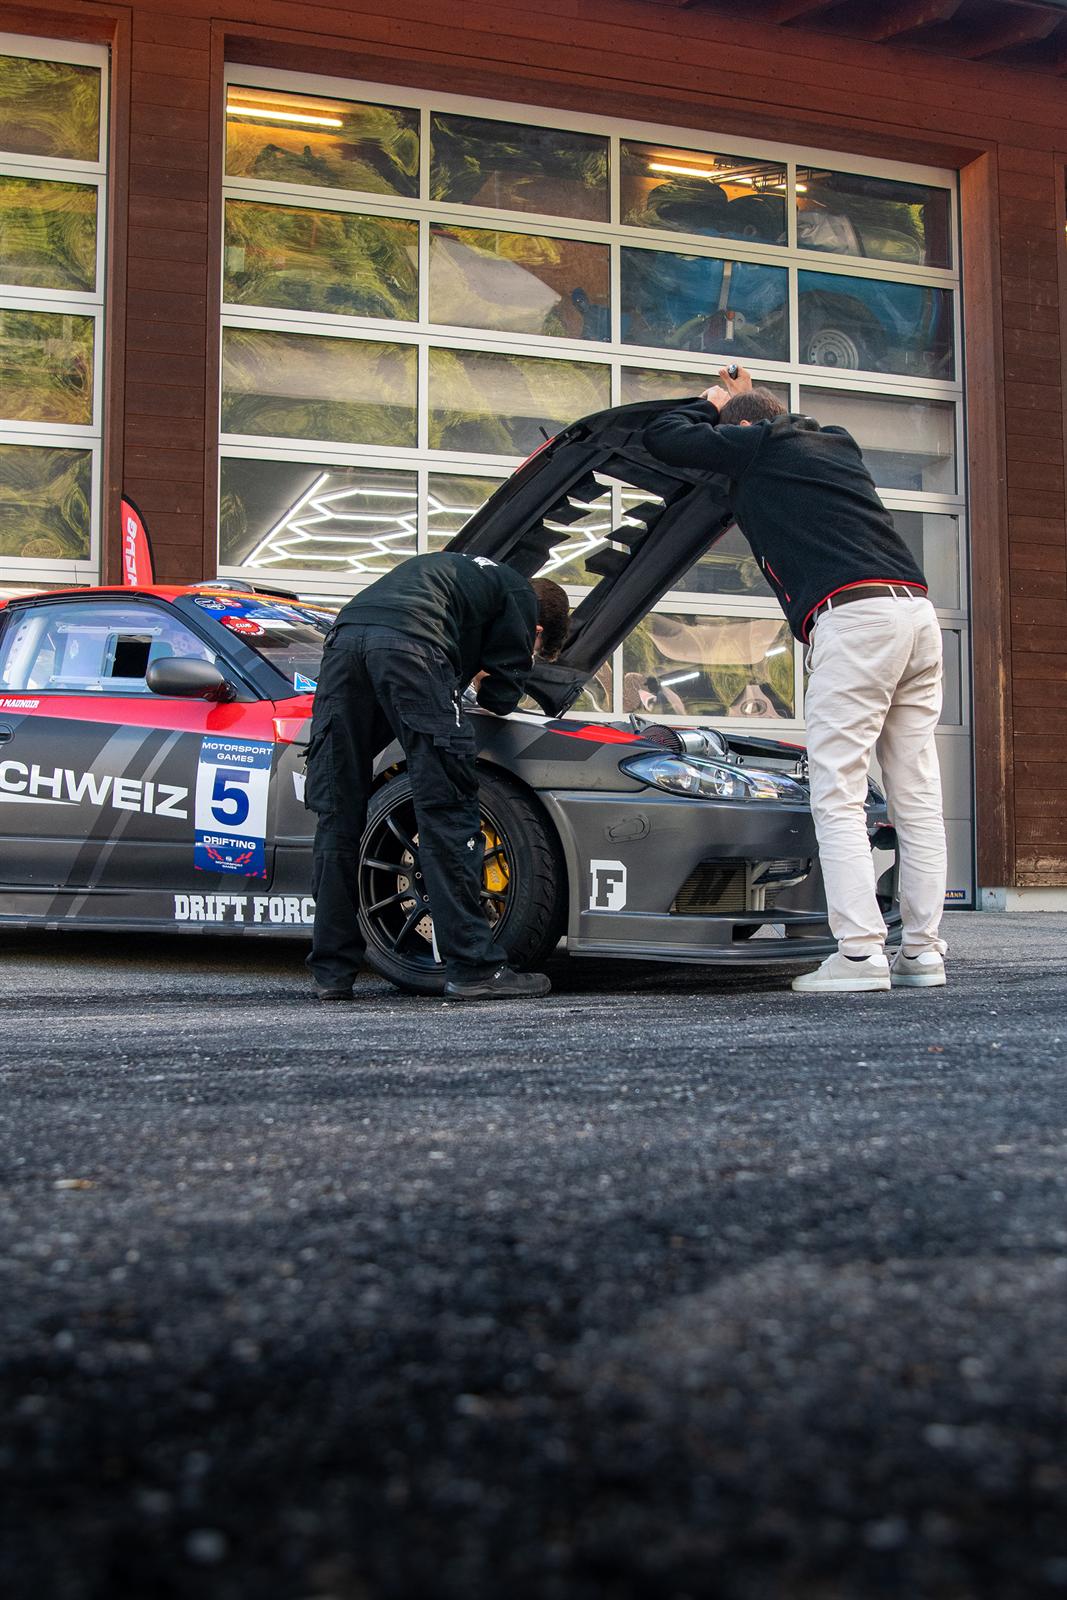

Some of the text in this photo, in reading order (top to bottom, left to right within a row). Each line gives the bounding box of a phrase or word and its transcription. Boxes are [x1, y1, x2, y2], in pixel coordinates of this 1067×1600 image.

[202, 742, 273, 756] MOTORSPORT
[217, 753, 254, 763] GAMES
[211, 767, 250, 826] 5
[203, 835, 256, 850] DRIFTING
[174, 894, 247, 922] DRIFT
